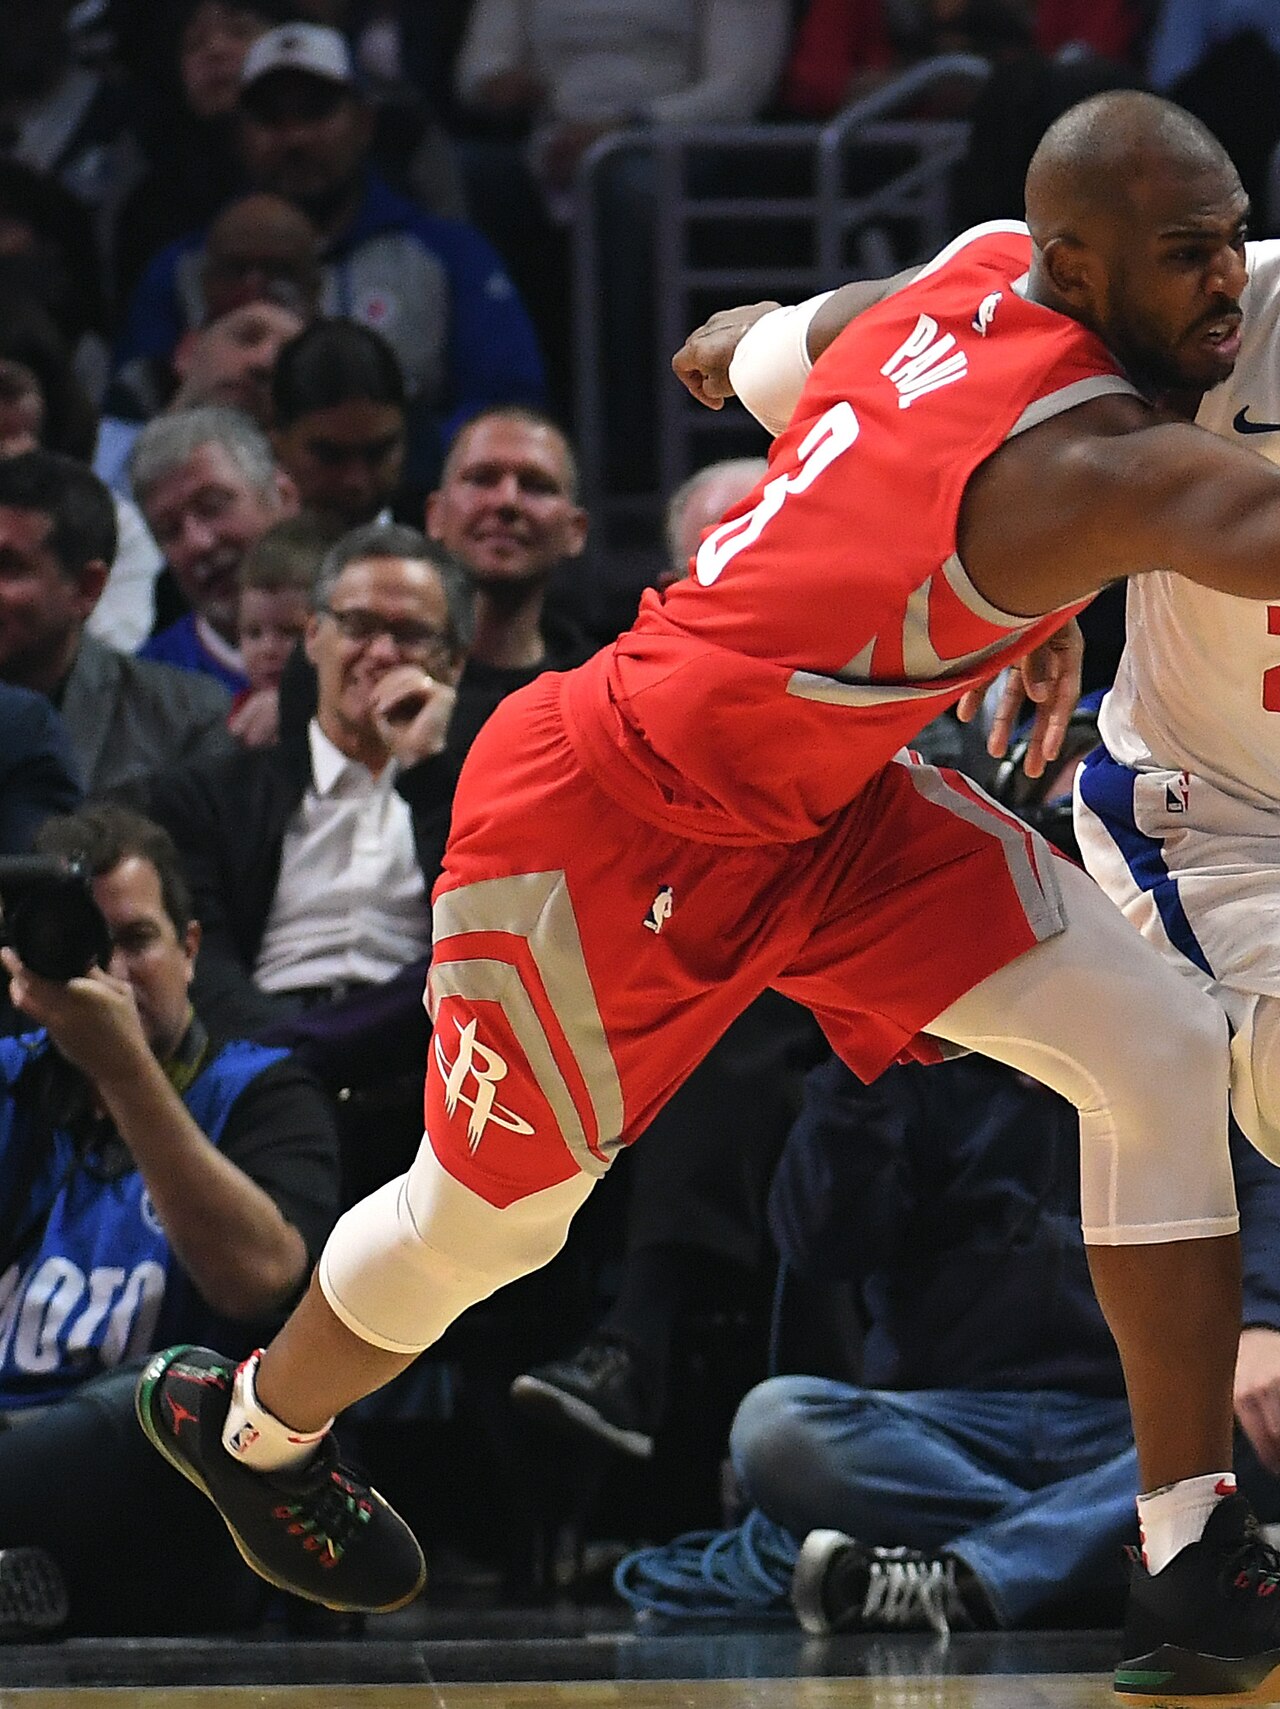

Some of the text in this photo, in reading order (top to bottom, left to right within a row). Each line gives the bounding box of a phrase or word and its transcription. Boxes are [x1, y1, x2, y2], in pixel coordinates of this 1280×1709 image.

[880, 313, 969, 410] PAUL
[696, 401, 860, 587] 3
[0, 1256, 166, 1373] OTO
